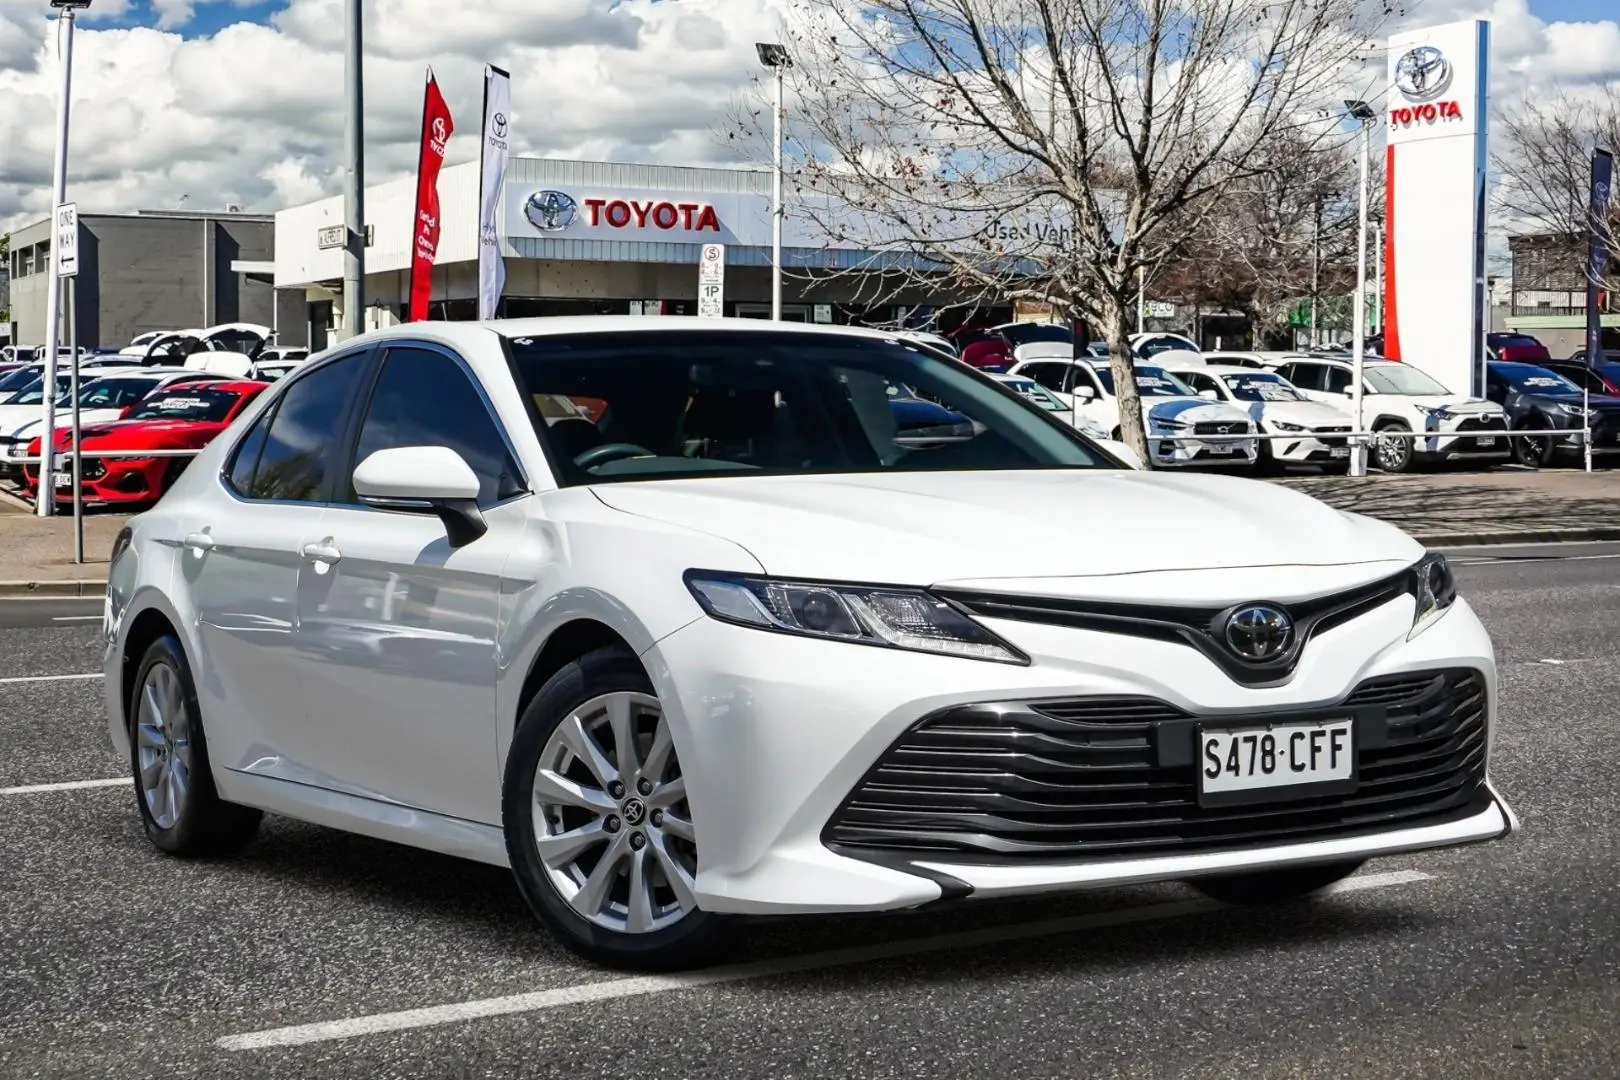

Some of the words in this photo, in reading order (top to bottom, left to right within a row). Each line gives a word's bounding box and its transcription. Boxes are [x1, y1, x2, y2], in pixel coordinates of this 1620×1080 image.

[1389, 101, 1463, 125] TOYOTA
[60, 209, 74, 228] ONE
[585, 199, 720, 232] TOYOTA
[60, 231, 76, 249] WAY
[704, 285, 719, 297] 1P
